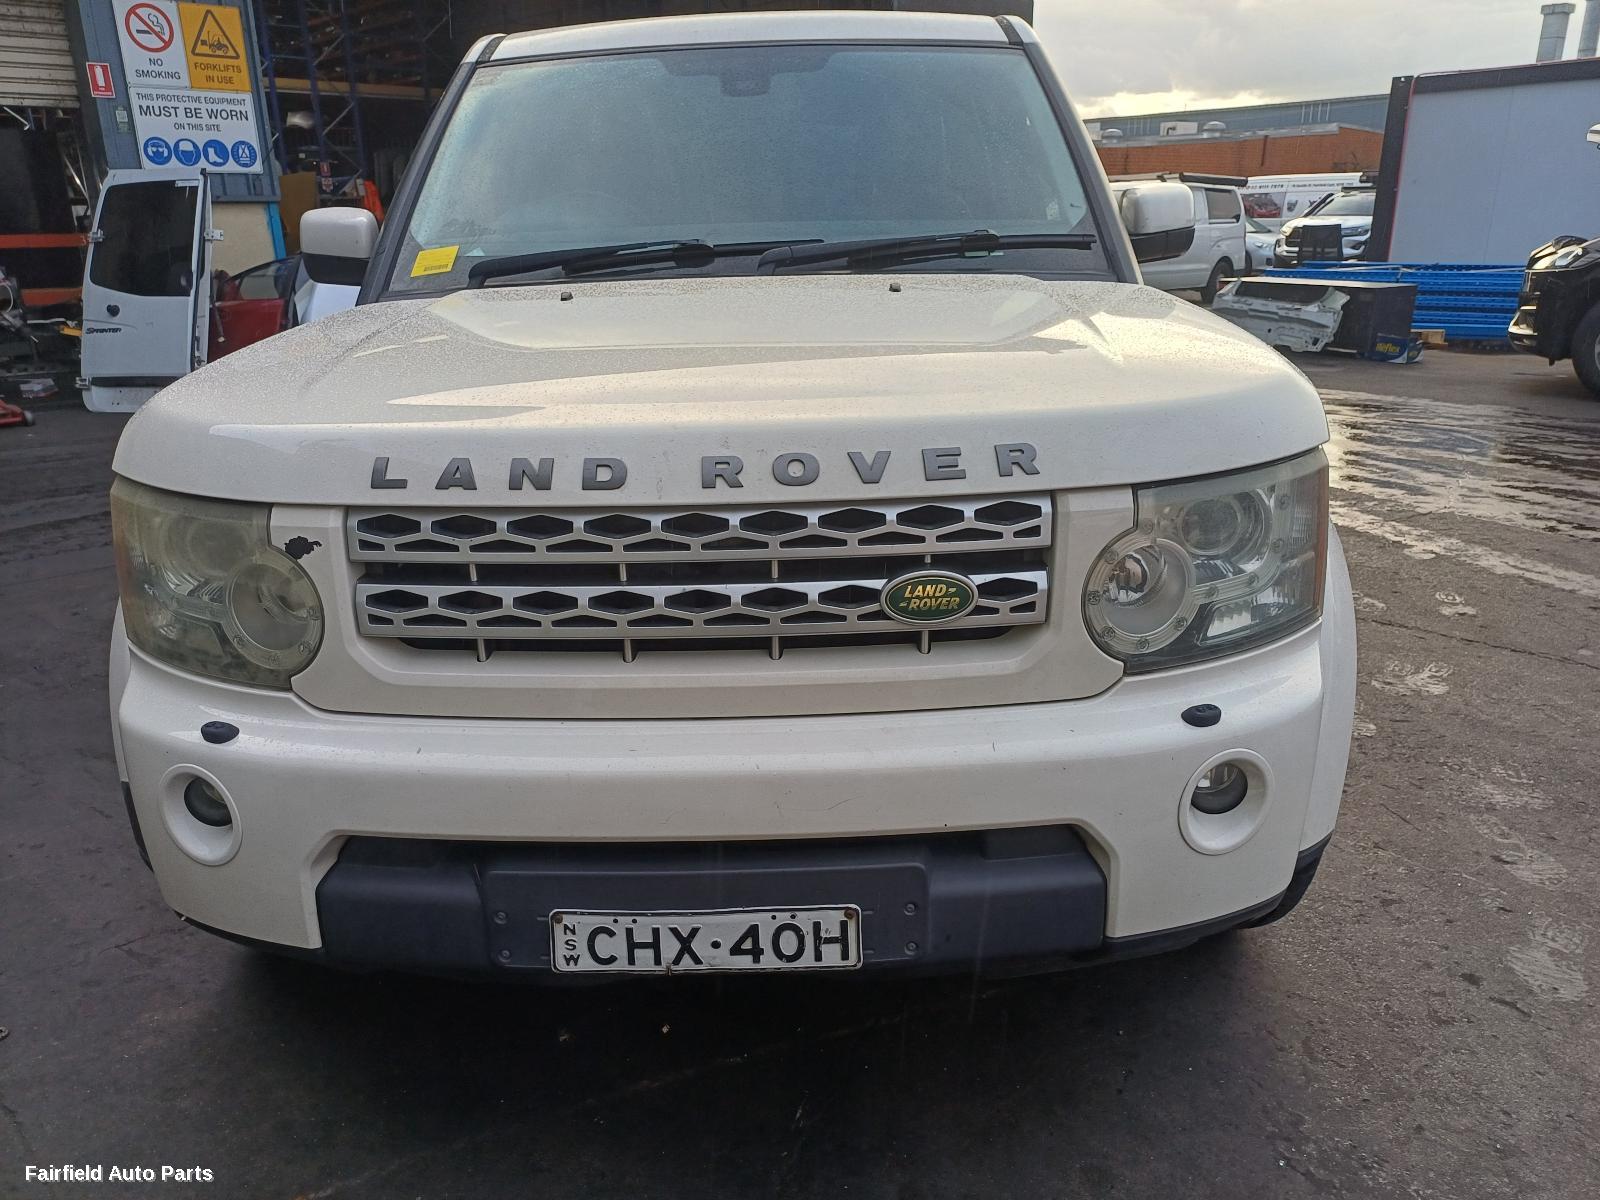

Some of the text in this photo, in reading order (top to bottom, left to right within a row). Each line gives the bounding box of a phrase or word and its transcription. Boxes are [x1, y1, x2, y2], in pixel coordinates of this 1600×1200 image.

[148, 58, 163, 67] NO
[194, 62, 242, 74] FORKLIFTS
[135, 69, 181, 80] SMOKING
[205, 75, 235, 85] IN USE
[136, 92, 246, 107] THIS PROTECTIVE EQUIPMENT
[138, 105, 249, 122] MUST BE WORN
[173, 122, 221, 133] ON THIS SITE
[370, 442, 1040, 491] LAND ROVER
